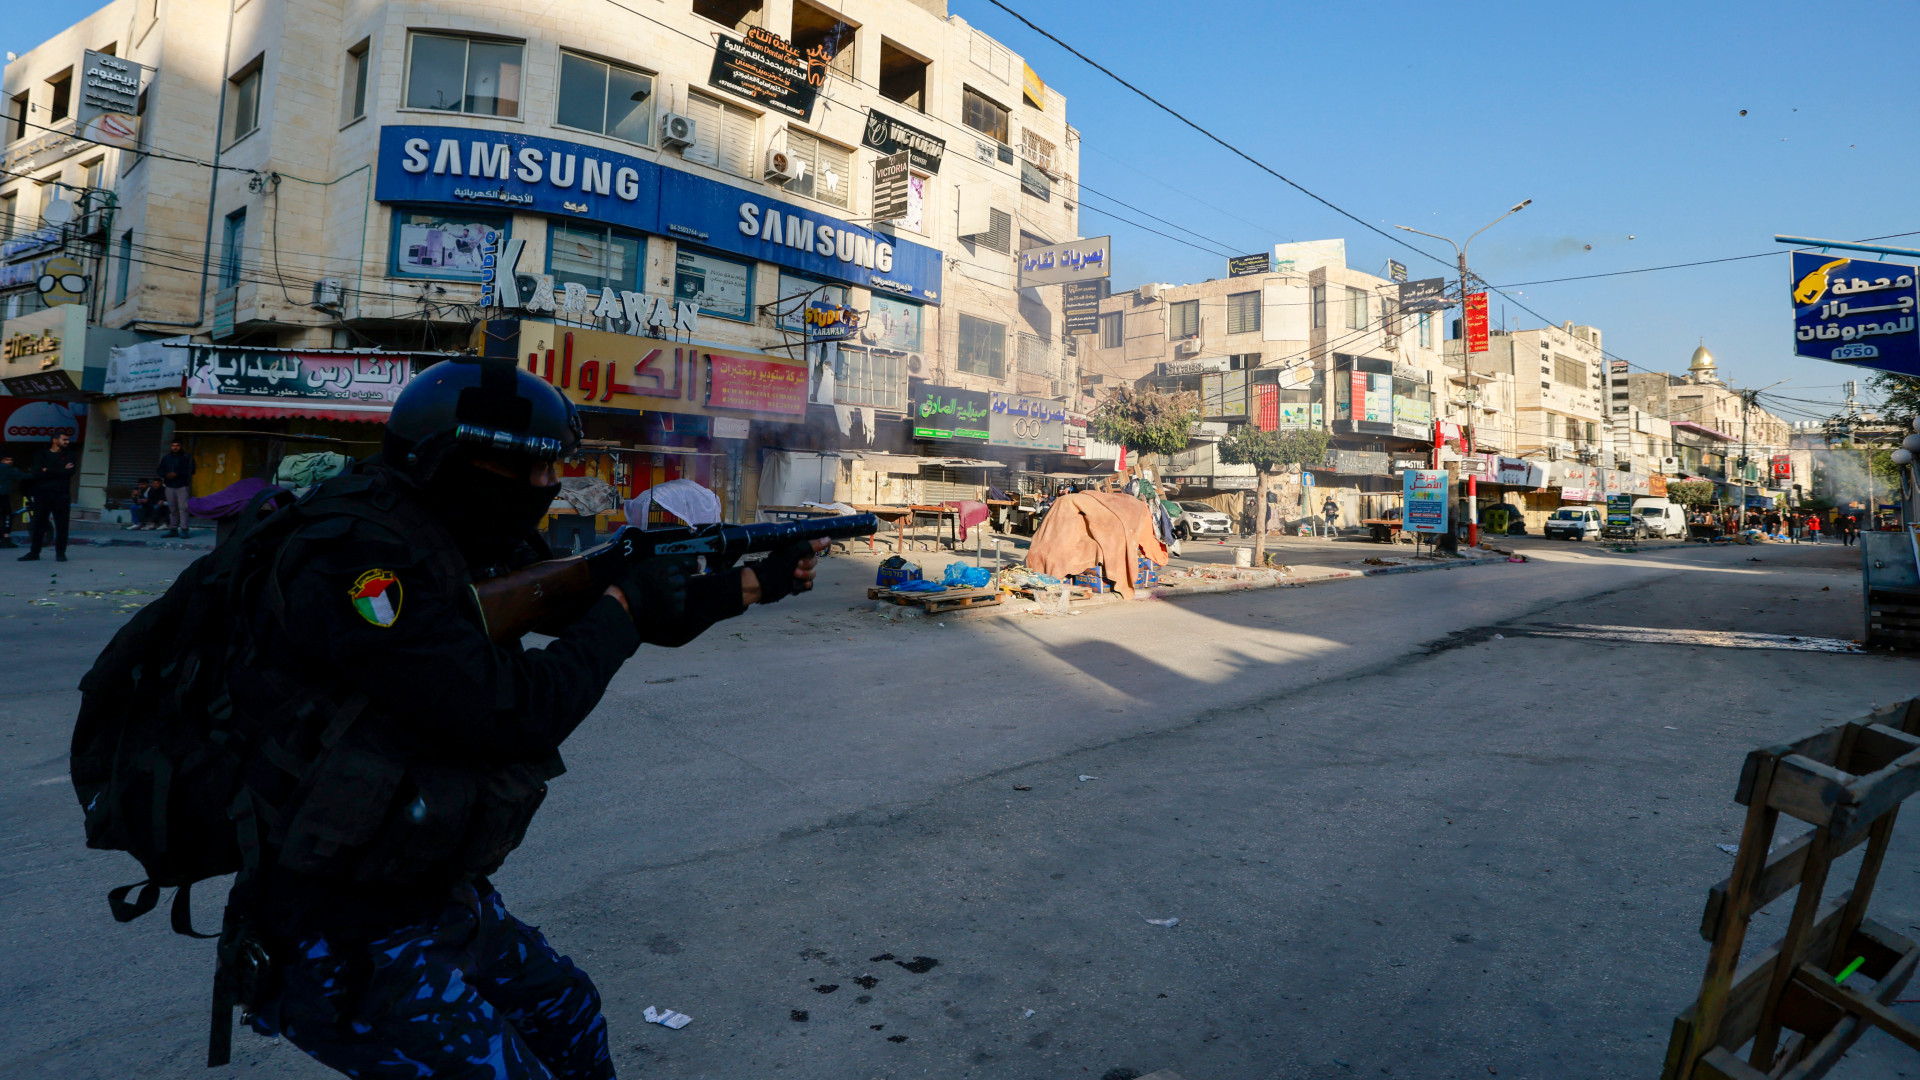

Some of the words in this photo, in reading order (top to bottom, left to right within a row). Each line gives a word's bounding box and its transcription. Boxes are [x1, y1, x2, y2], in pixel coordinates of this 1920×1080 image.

[743, 38, 764, 51] Crown
[764, 46, 784, 60] Dental
[783, 54, 800, 67] Clinic
[765, 59, 784, 71] محمد
[784, 65, 807, 80] الدكتور
[87, 68, 137, 87] بريميوم
[890, 122, 943, 158] VICTORIA
[402, 138, 639, 200] SAMSUNG
[876, 162, 908, 178] VICTORIA
[454, 187, 499, 200] الكهربائية
[739, 202, 893, 273] SAMSUNG
[1023, 251, 1056, 271] تفاحة
[1061, 248, 1104, 271] بصريات
[480, 231, 497, 308] STUDIO
[1832, 275, 1913, 295] محطة
[1820, 296, 1914, 320] جرار
[1797, 316, 1915, 341] للمحروقات
[1835, 347, 1874, 358] 1950
[215, 353, 303, 386] للهدايا
[307, 357, 403, 389] الفارس
[720, 363, 757, 379] ومختبرات
[759, 369, 785, 382] ستوديو
[786, 370, 805, 385] شركة
[250, 385, 269, 395] شنط
[275, 388, 299, 397] عطور
[306, 389, 328, 397] تحف
[334, 390, 350, 399] cd
[358, 391, 383, 401] هدايا
[919, 394, 956, 419] الصادق
[956, 401, 987, 422] صيدلية
[992, 393, 1029, 415] تفاحة
[1031, 401, 1065, 425] بصريات
[8, 426, 76, 436] ooredoo
[1409, 481, 1442, 491] الأمل
[1415, 472, 1437, 482] مركز
